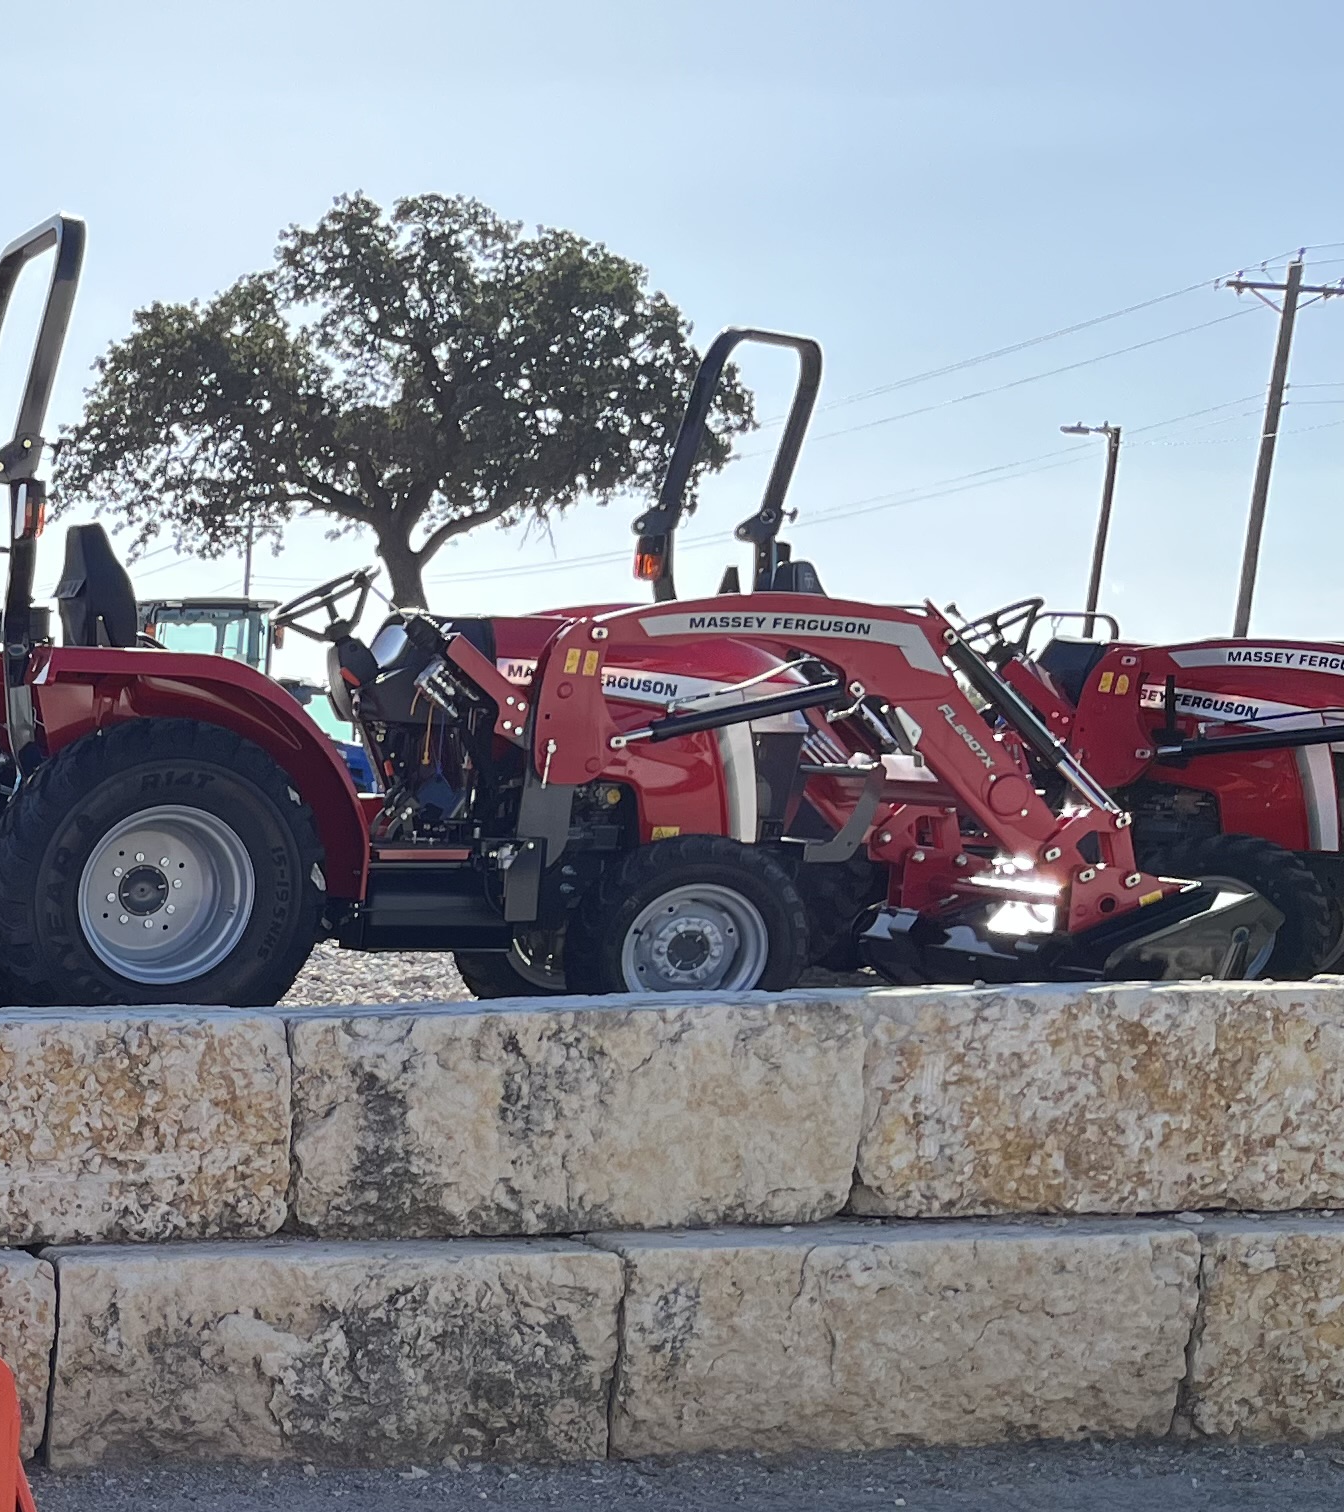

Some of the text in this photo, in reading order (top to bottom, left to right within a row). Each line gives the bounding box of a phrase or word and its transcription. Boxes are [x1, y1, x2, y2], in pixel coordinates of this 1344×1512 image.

[689, 616, 872, 635] MASSEY FERGUSON
[1228, 651, 1295, 665] MASSEY
